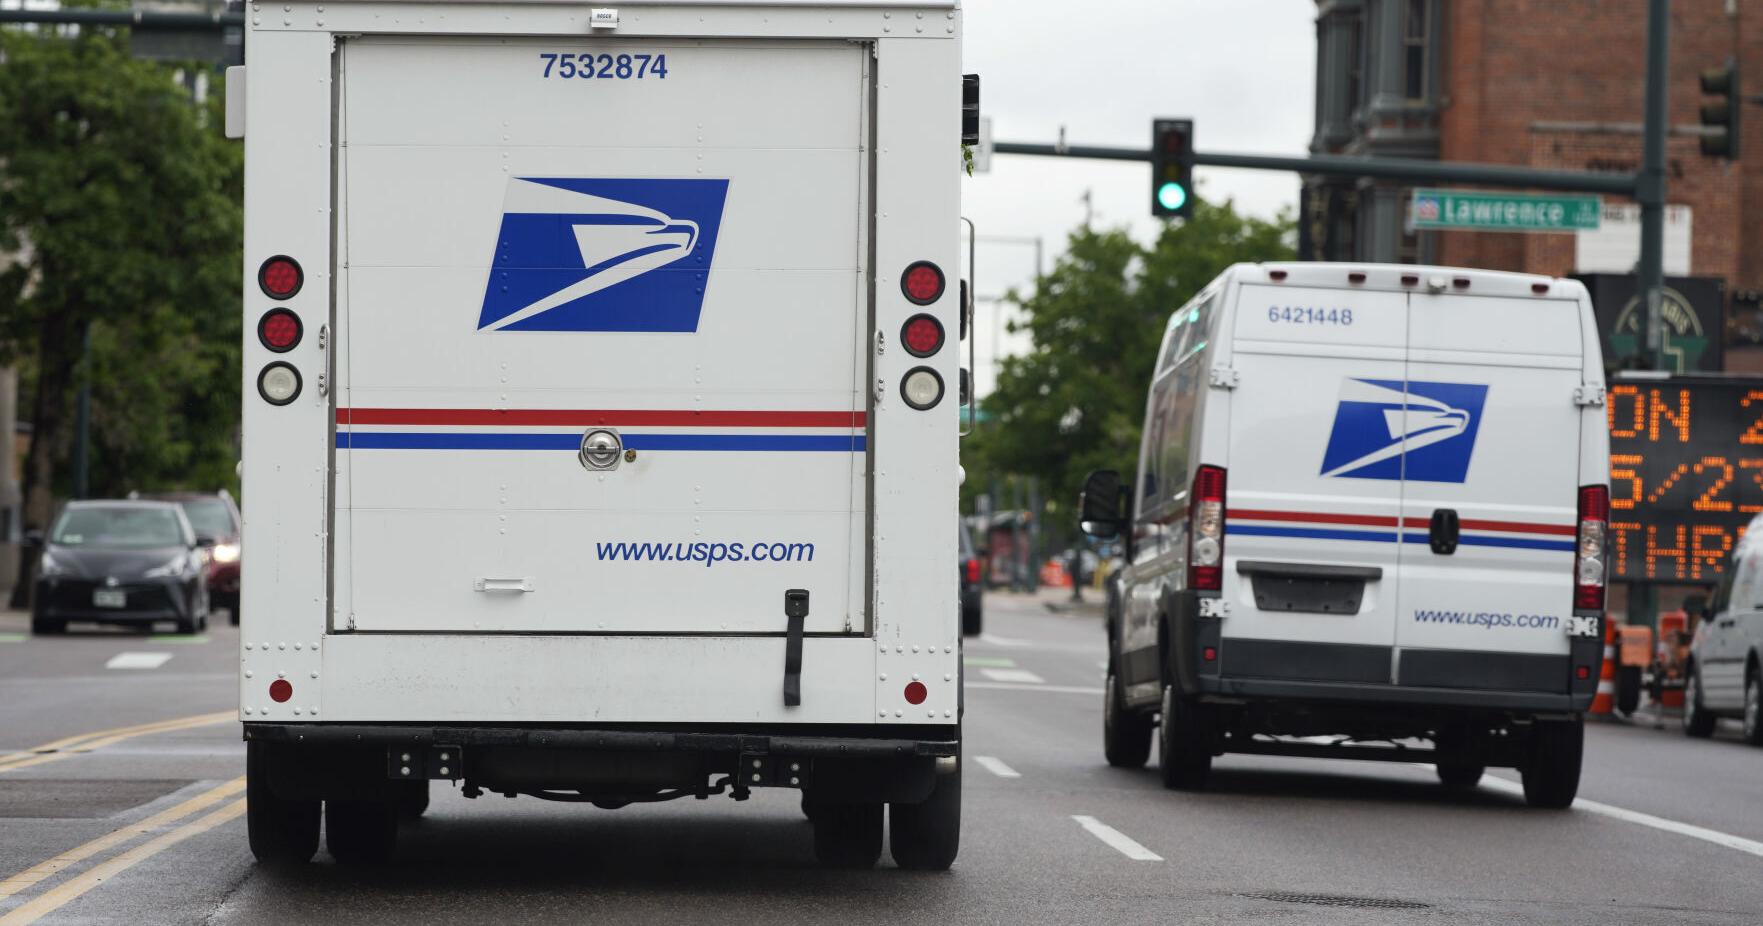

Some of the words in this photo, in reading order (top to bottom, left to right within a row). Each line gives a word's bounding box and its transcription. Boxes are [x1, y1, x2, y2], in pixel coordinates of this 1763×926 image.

[540, 53, 668, 79] 7532874
[1445, 198, 1565, 224] Lawrence
[1268, 306, 1353, 326] 6421448
[1607, 385, 1690, 442] ON
[596, 542, 815, 567] www.usps.com
[1608, 522, 1746, 579] THR
[1414, 609, 1559, 629] www.usps.com
